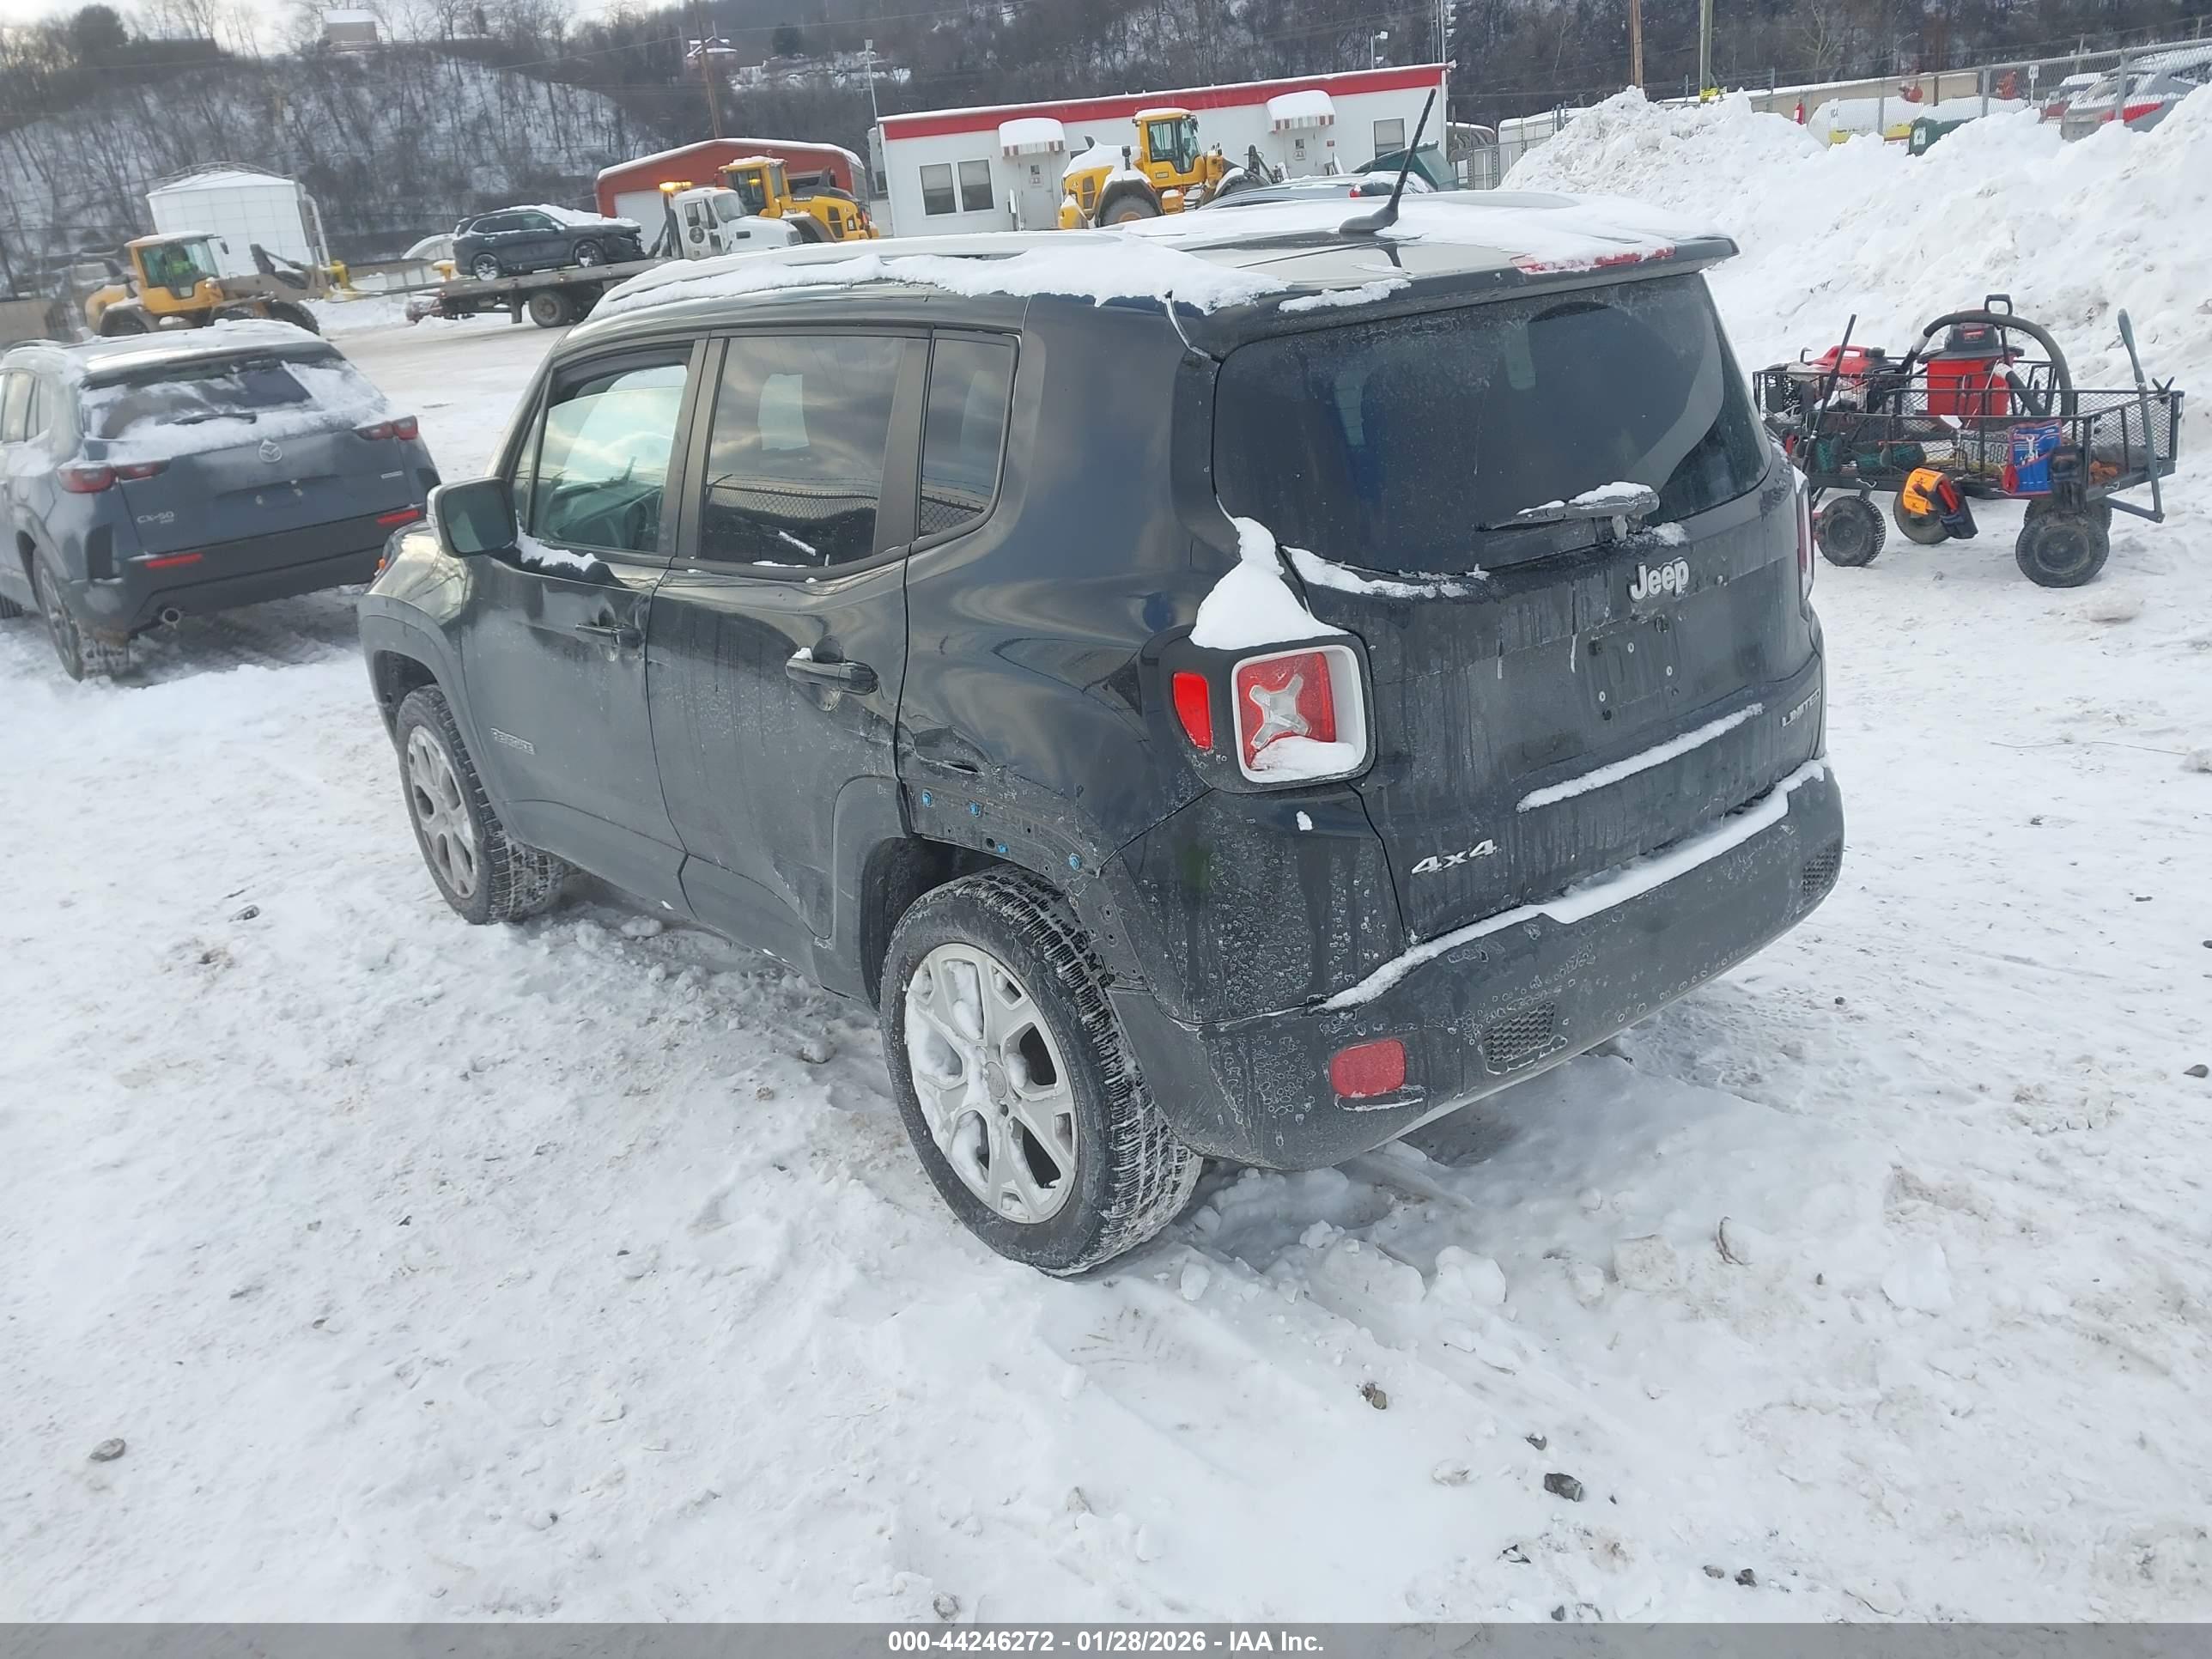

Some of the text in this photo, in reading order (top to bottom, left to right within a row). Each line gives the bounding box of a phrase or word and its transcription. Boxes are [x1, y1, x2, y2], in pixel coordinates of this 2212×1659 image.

[1628, 556, 1689, 601] Jeep
[1781, 688, 1821, 727] LIMITED
[1411, 839, 1497, 874] 4x4
